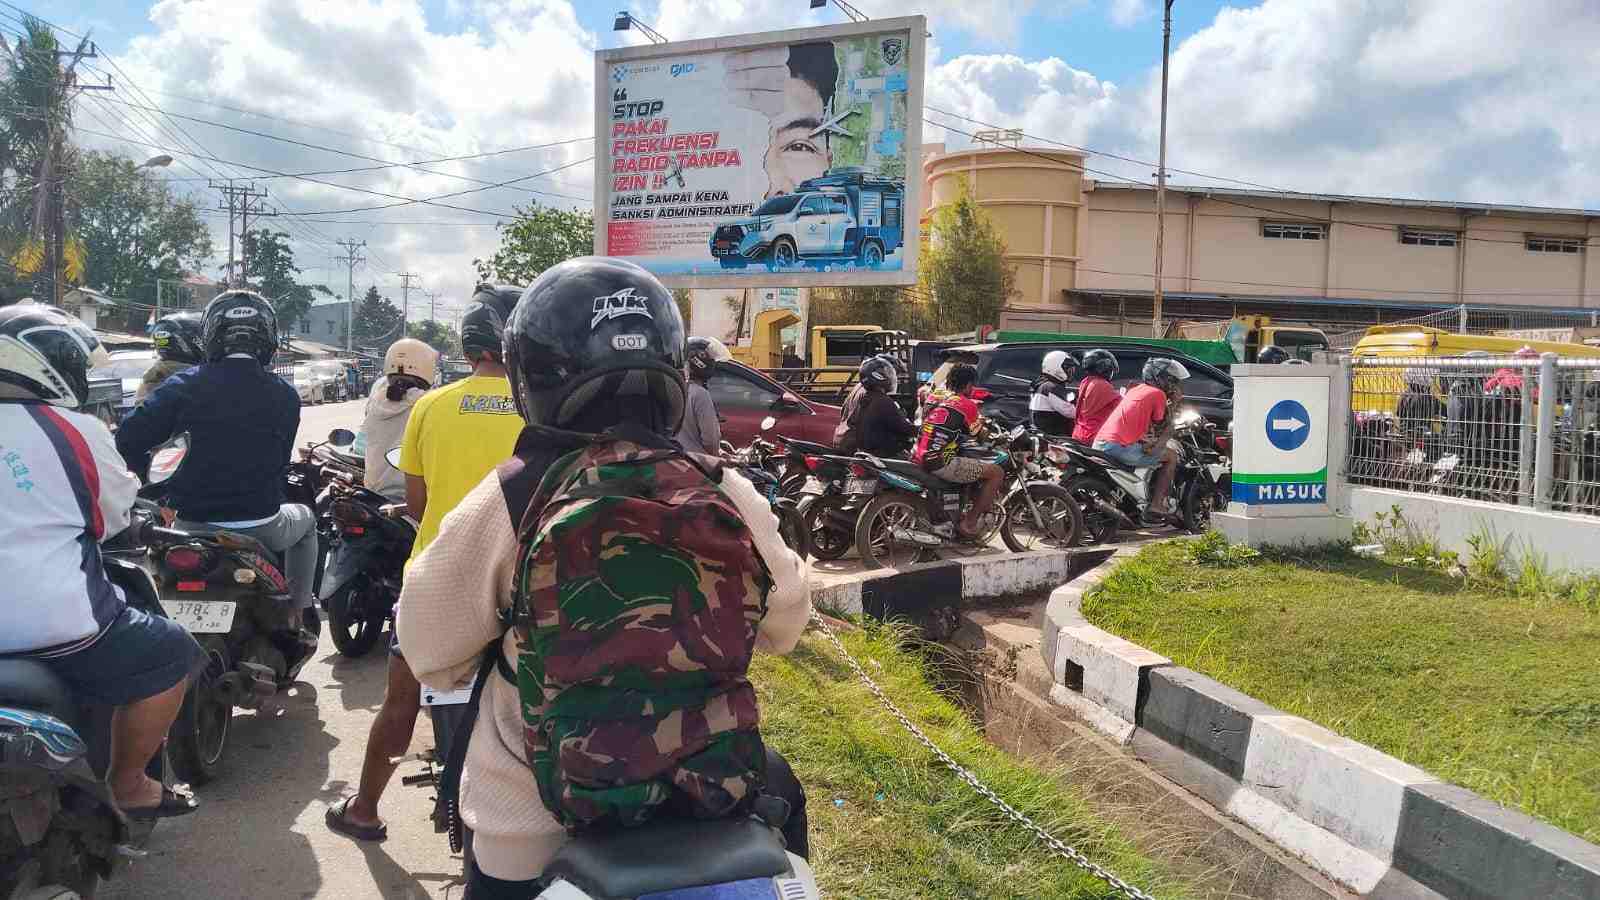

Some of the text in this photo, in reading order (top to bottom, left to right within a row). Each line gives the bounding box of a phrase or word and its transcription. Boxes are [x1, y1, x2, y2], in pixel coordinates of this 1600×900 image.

[613, 100, 664, 119] STOP
[612, 119, 667, 136] PAKAI
[612, 131, 719, 155] FREKUENSI
[612, 148, 742, 173] RADIO TANPA
[613, 173, 647, 192] IZIN
[612, 190, 729, 207] JANG SAMPAI KENA
[612, 202, 753, 220] SANKSI ADMINISTRATIF!
[616, 336, 642, 348] DOT
[1258, 483, 1324, 500] MASUK
